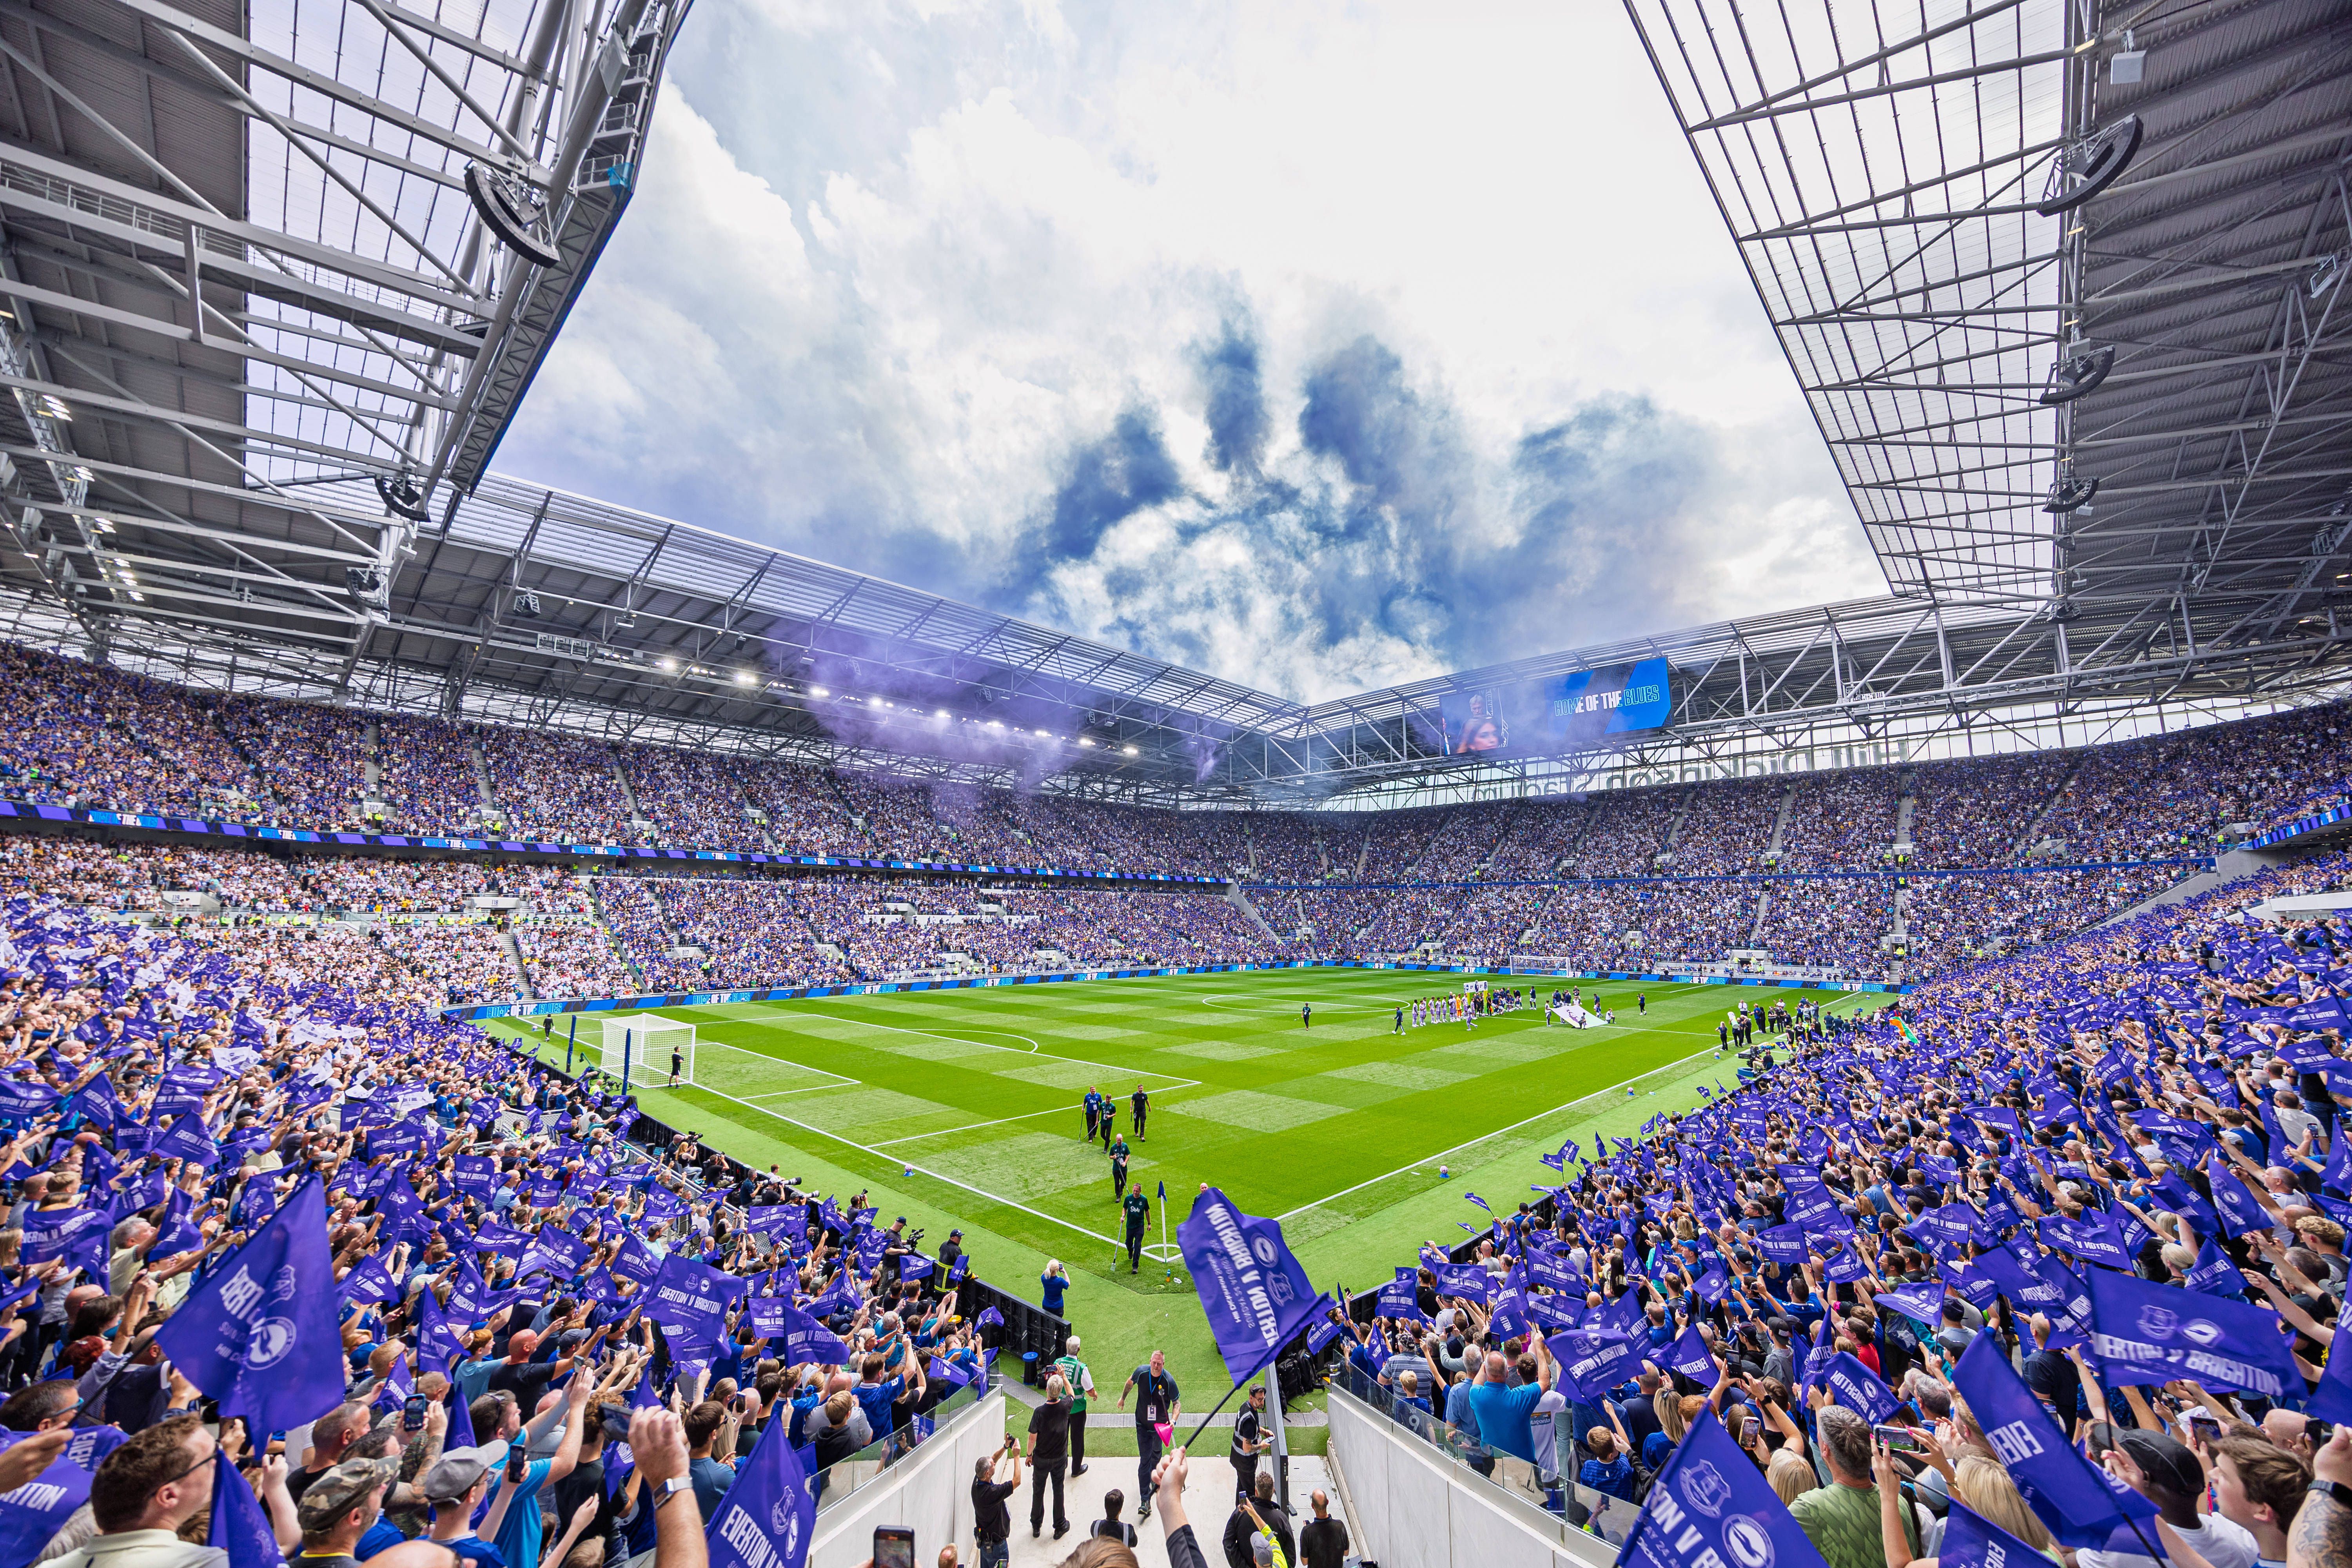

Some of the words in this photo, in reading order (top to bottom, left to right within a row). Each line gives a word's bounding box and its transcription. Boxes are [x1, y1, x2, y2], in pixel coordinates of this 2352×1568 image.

[1554, 697, 1584, 717] HOME
[1585, 694, 1599, 712] OF
[1600, 690, 1622, 709] THE
[1624, 685, 1660, 706] BLUES
[865, 985, 873, 995] OF
[882, 984, 897, 993] BLUES
[1852, 983, 1863, 991] THE
[1863, 984, 1883, 992] BLUES
[693, 996, 710, 1005] HOME
[711, 995, 719, 1004] OF
[720, 993, 732, 1003] THE
[732, 992, 750, 1002] BLUES
[486, 1007, 509, 1018] HOME
[510, 1005, 521, 1016] OF
[522, 1004, 537, 1015] THE
[538, 1003, 563, 1014] BLUES
[372, 1139, 392, 1149] EVERTON
[622, 1253, 639, 1264] EVERTON
[1533, 1263, 1552, 1273] EVERTON
[1556, 1270, 1577, 1282] BRIGHTON
[657, 1285, 689, 1305] EVERTON
[688, 1295, 695, 1306] V
[694, 1296, 722, 1314] BRIGHTON
[788, 1330, 806, 1346] VERTON
[808, 1330, 813, 1341] V
[1569, 1359, 1597, 1379] EVERTON
[1594, 1354, 1602, 1366] V
[1599, 1343, 1630, 1363] BRIGHTON
[2185, 1349, 2284, 1397] BRIGHTON
[720, 1504, 772, 1568] EVERTON
